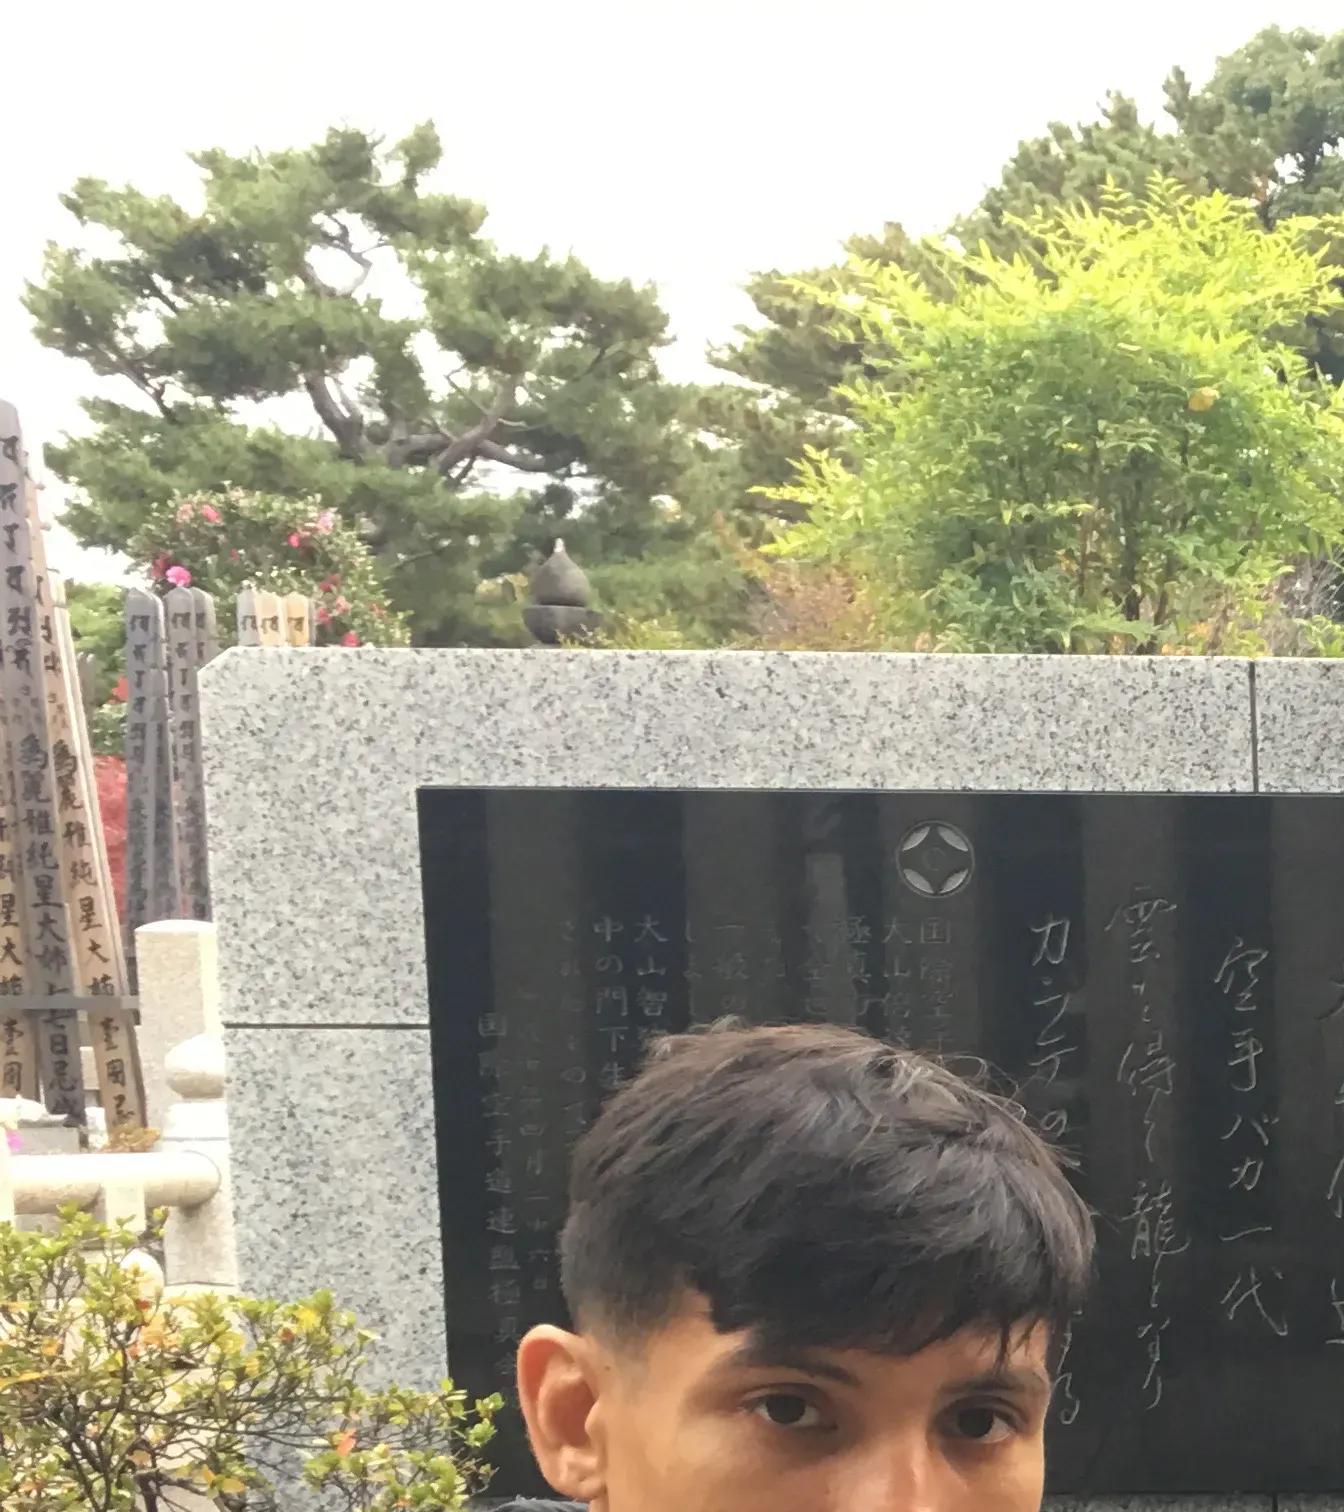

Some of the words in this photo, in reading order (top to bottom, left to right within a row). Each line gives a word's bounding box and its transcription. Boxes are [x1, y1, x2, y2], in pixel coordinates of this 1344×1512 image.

[1214, 935, 1290, 1337] 空手バカ一代
